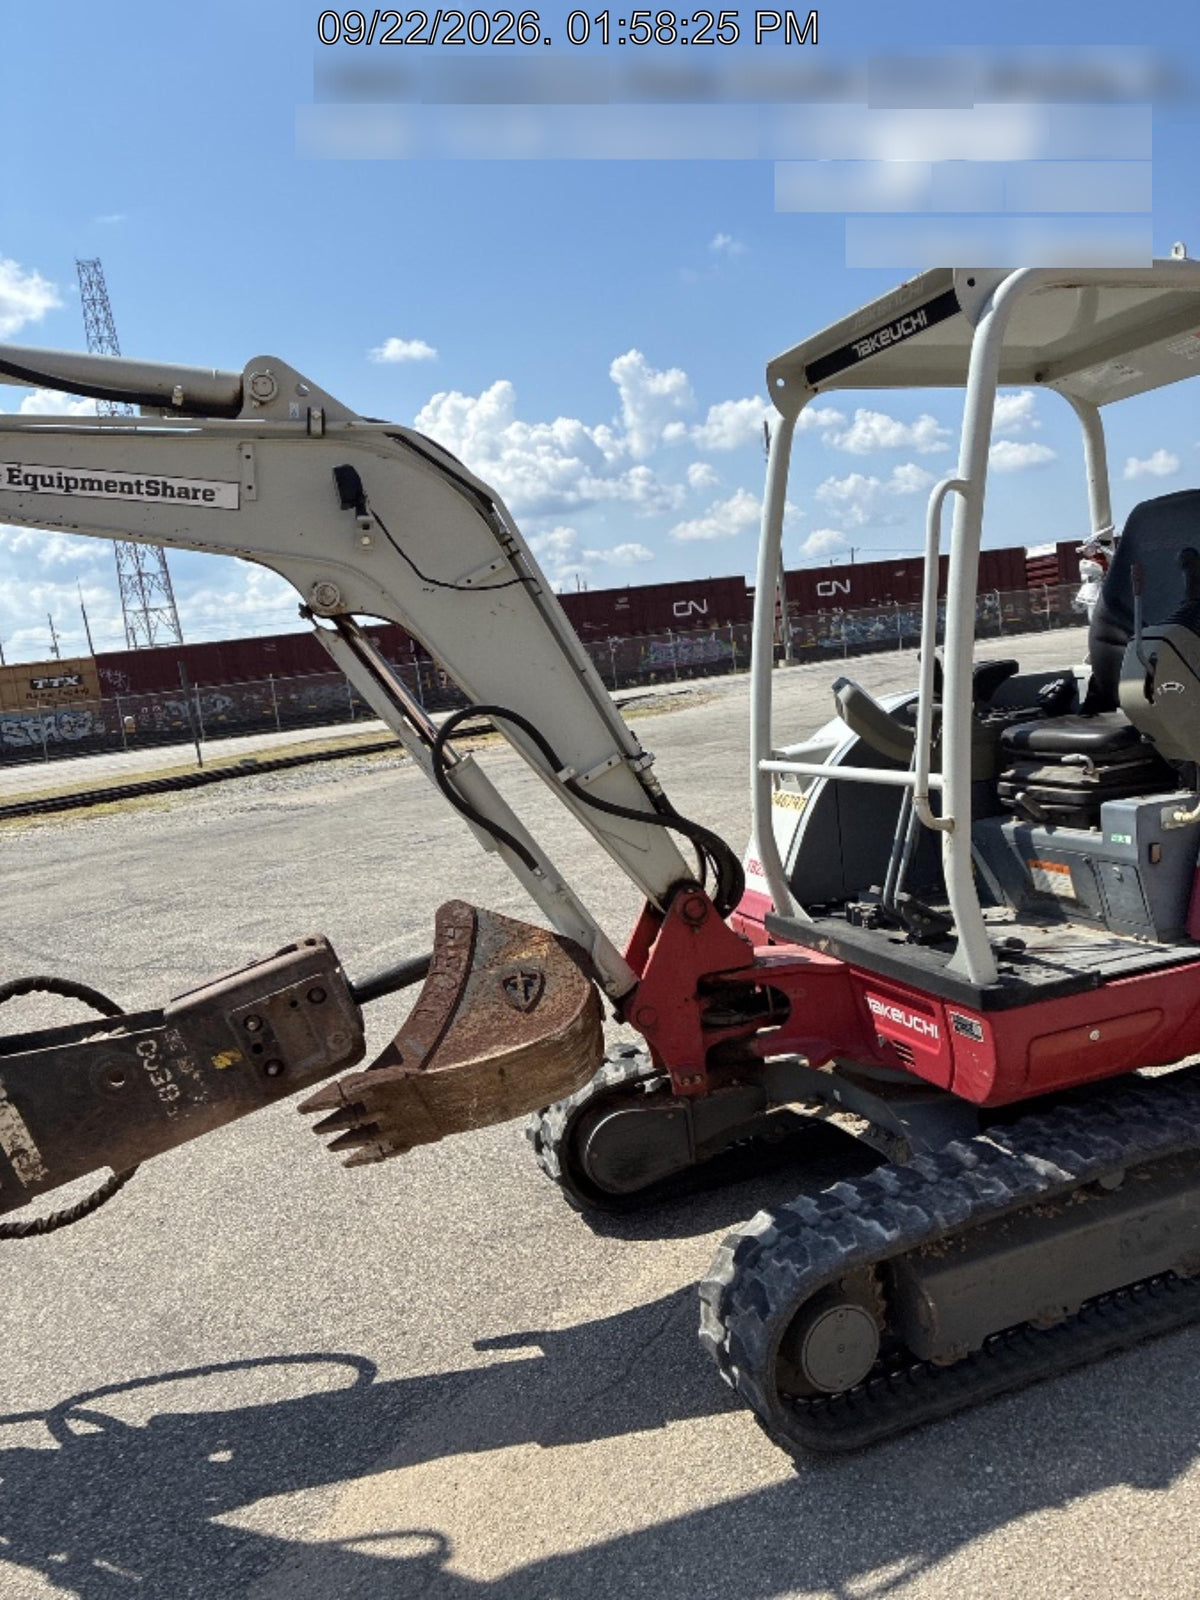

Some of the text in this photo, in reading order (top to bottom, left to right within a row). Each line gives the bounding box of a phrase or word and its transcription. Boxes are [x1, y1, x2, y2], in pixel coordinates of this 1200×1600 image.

[6, 466, 216, 502] EquipmentShare
[816, 579, 850, 596] CN
[672, 598, 708, 617] CN
[32, 674, 80, 689] TTX
